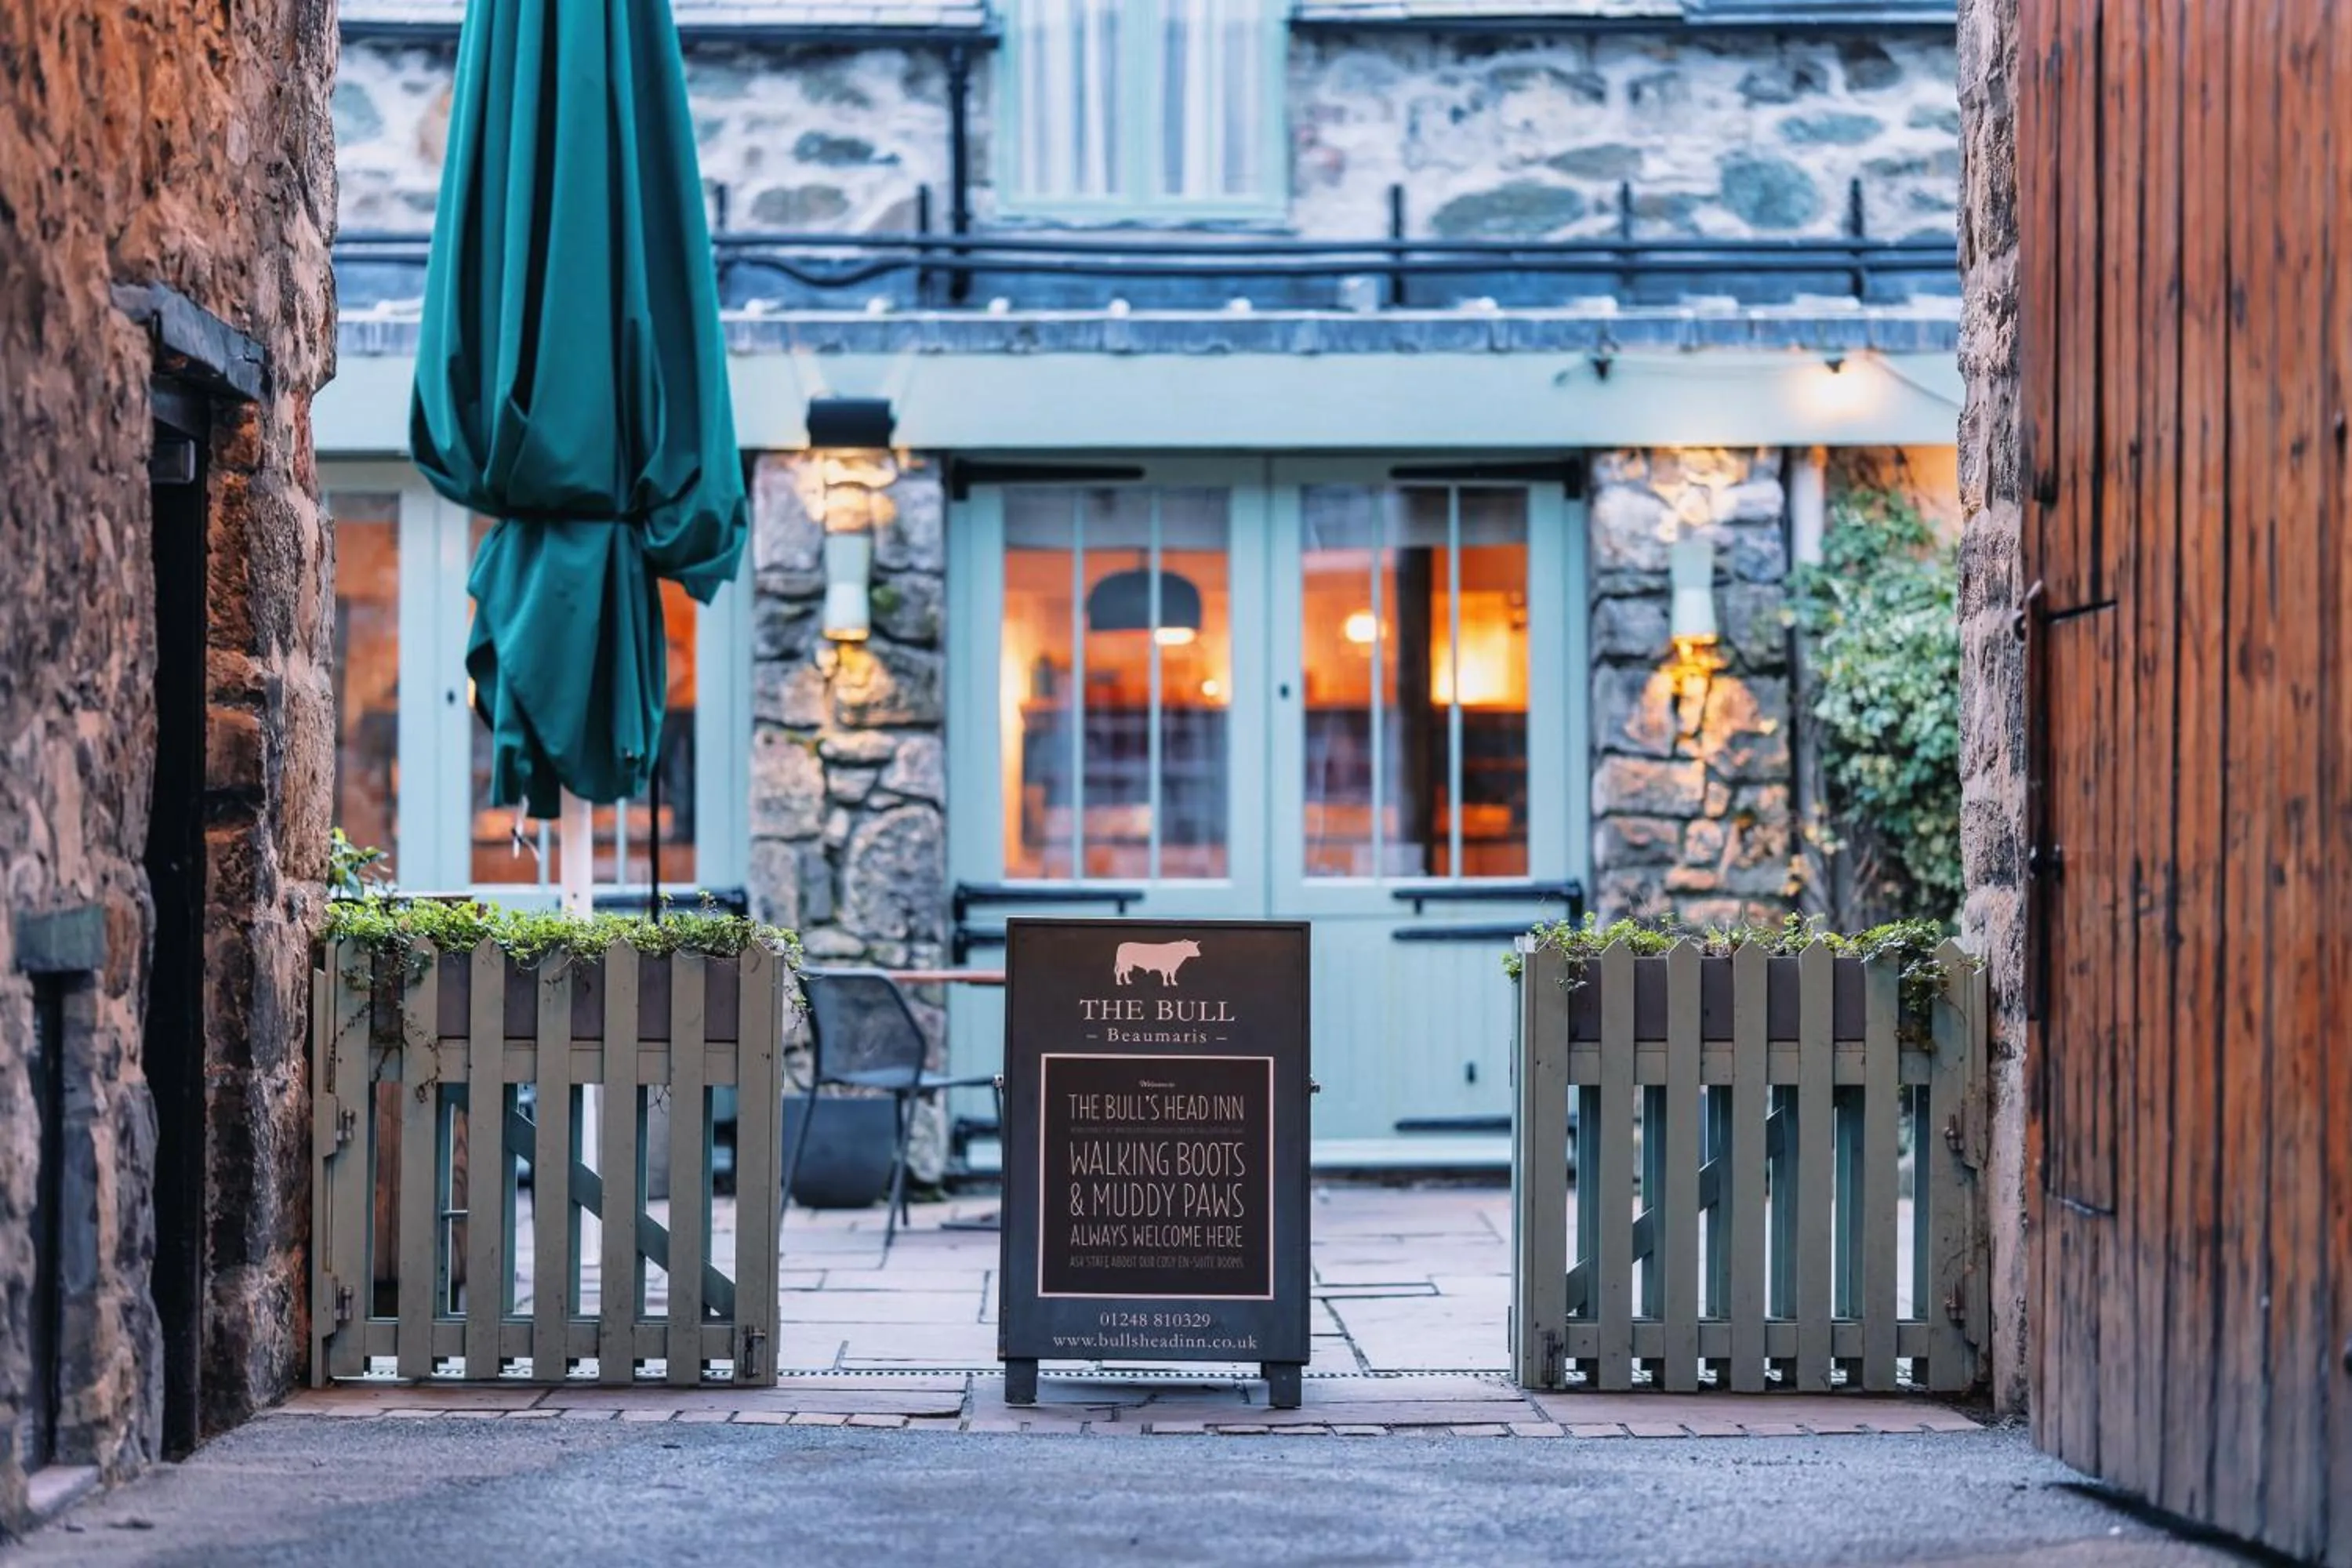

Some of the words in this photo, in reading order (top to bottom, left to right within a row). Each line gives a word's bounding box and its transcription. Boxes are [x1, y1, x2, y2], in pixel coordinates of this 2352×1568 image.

[1079, 999, 1145, 1021] THE
[1156, 1000, 1236, 1022] BULL
[1107, 1028, 1207, 1044] Beaumaris
[1068, 1094, 1100, 1120] THE
[1105, 1094, 1160, 1121] BULL'S
[1165, 1095, 1209, 1121] HEAD
[1214, 1095, 1245, 1121] INN
[1069, 1141, 1170, 1176] WALKING
[1177, 1142, 1247, 1178] BOOTS
[1069, 1182, 1085, 1217] &
[1093, 1182, 1176, 1218] MUDDY
[1184, 1182, 1245, 1218] PAWS
[1070, 1224, 1127, 1247] ALWAYS
[1132, 1225, 1202, 1248] WELCOME
[1207, 1225, 1243, 1248] HERE
[1100, 1311, 1148, 1327] 01248
[1153, 1312, 1211, 1328] 810329
[1053, 1333, 1258, 1350] www.bullsheadinn.co.uk
